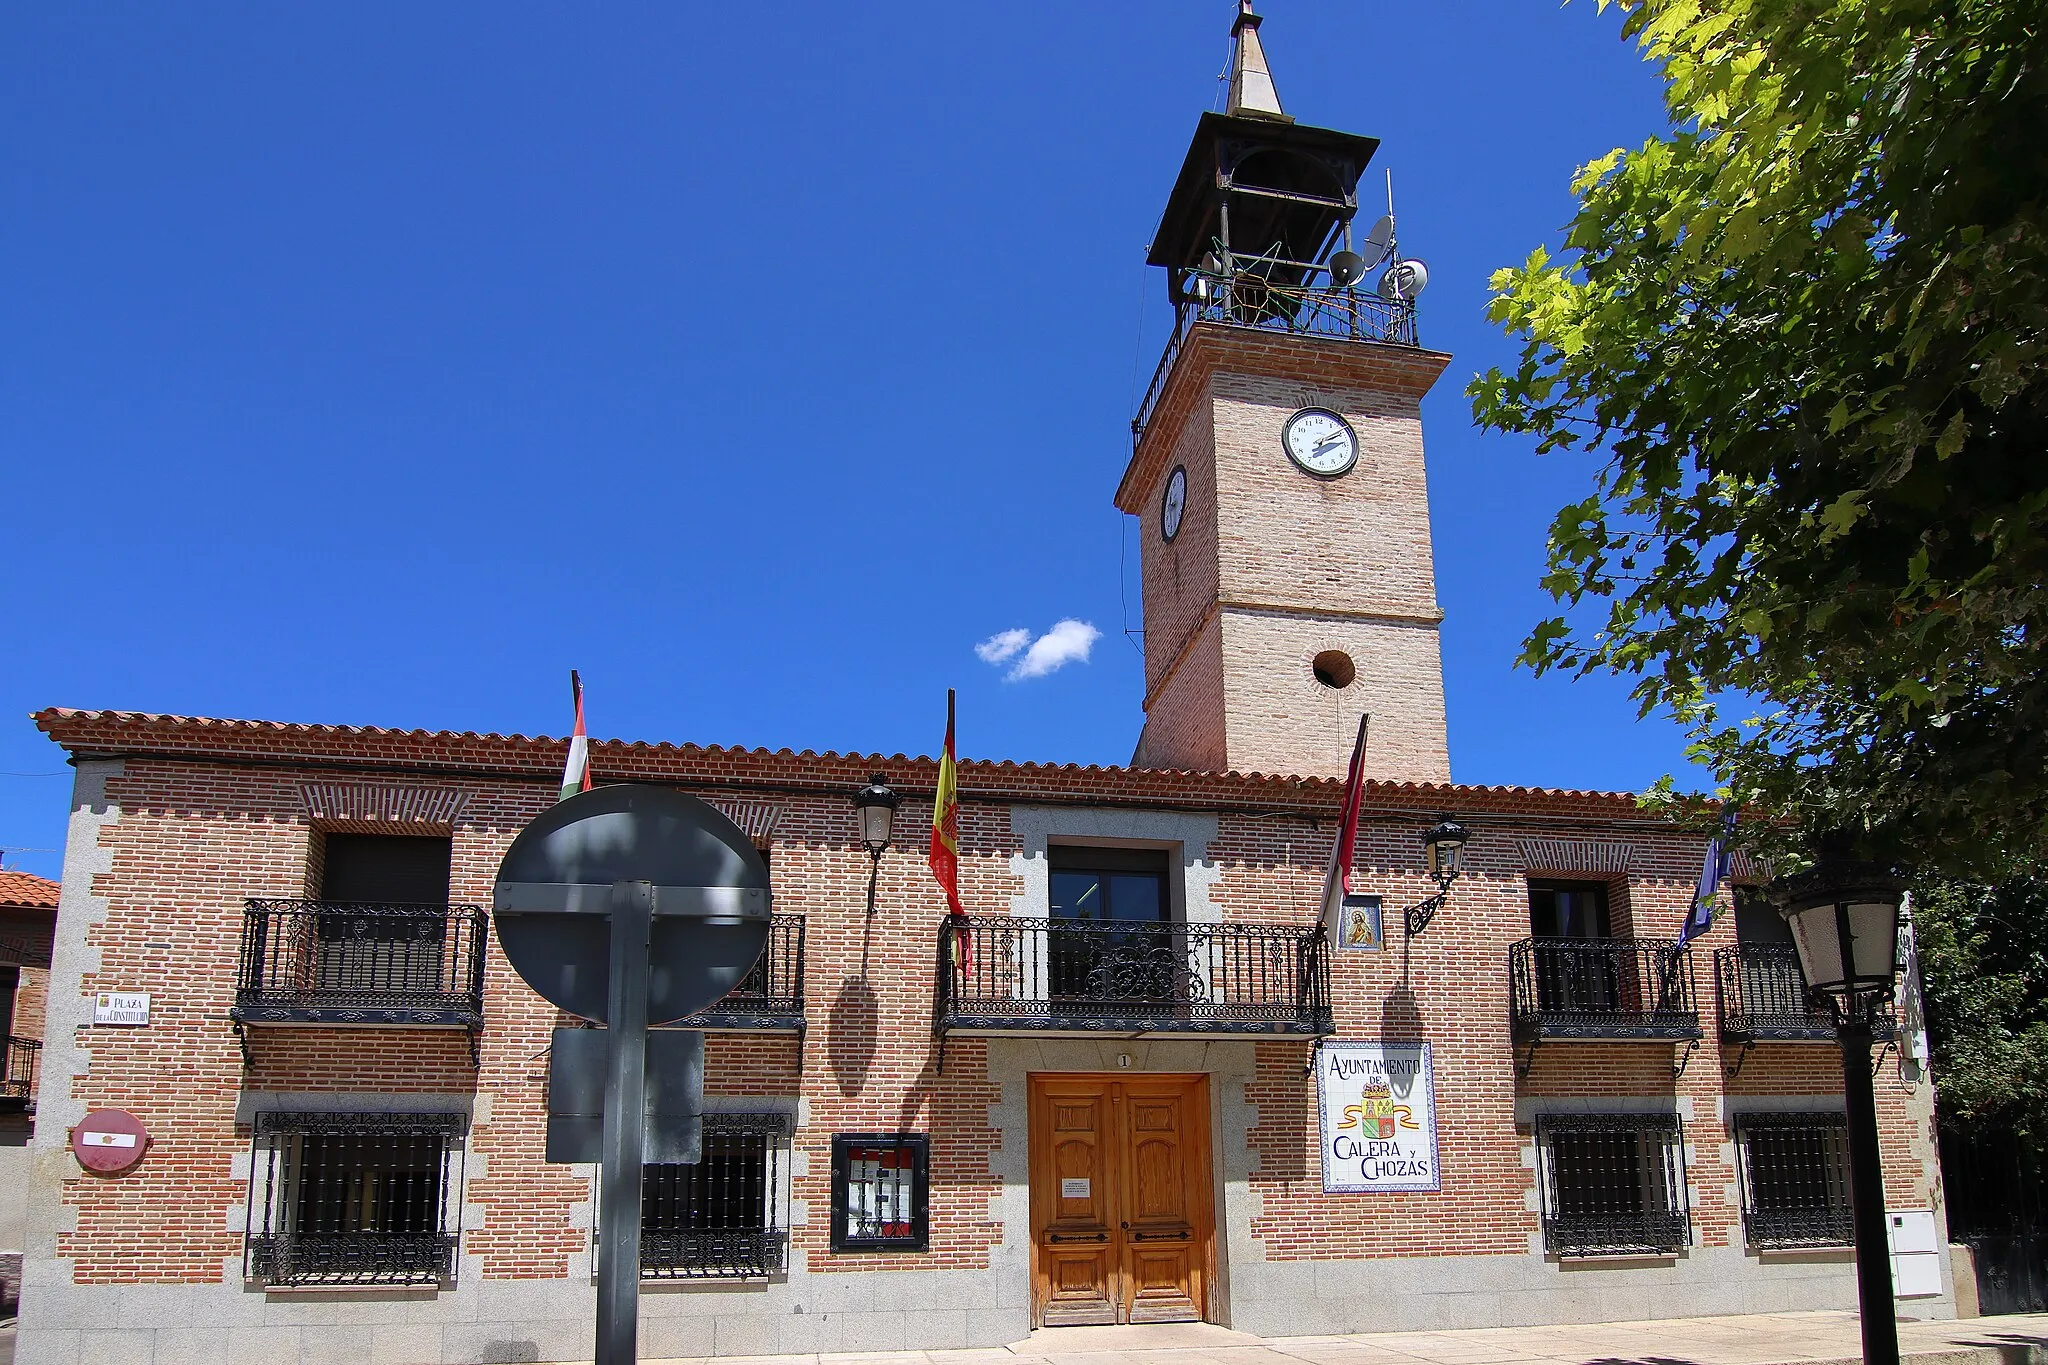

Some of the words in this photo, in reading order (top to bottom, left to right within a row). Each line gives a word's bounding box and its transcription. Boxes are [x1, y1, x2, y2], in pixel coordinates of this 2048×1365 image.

[114, 998, 142, 1008] PLAZA
[1122, 1055, 1127, 1066] 1
[1329, 1053, 1421, 1080] AYUNTAMIENTO
[1369, 1076, 1382, 1084] DE
[1333, 1136, 1401, 1160] CALERA
[1361, 1156, 1428, 1180] CHOZAS
